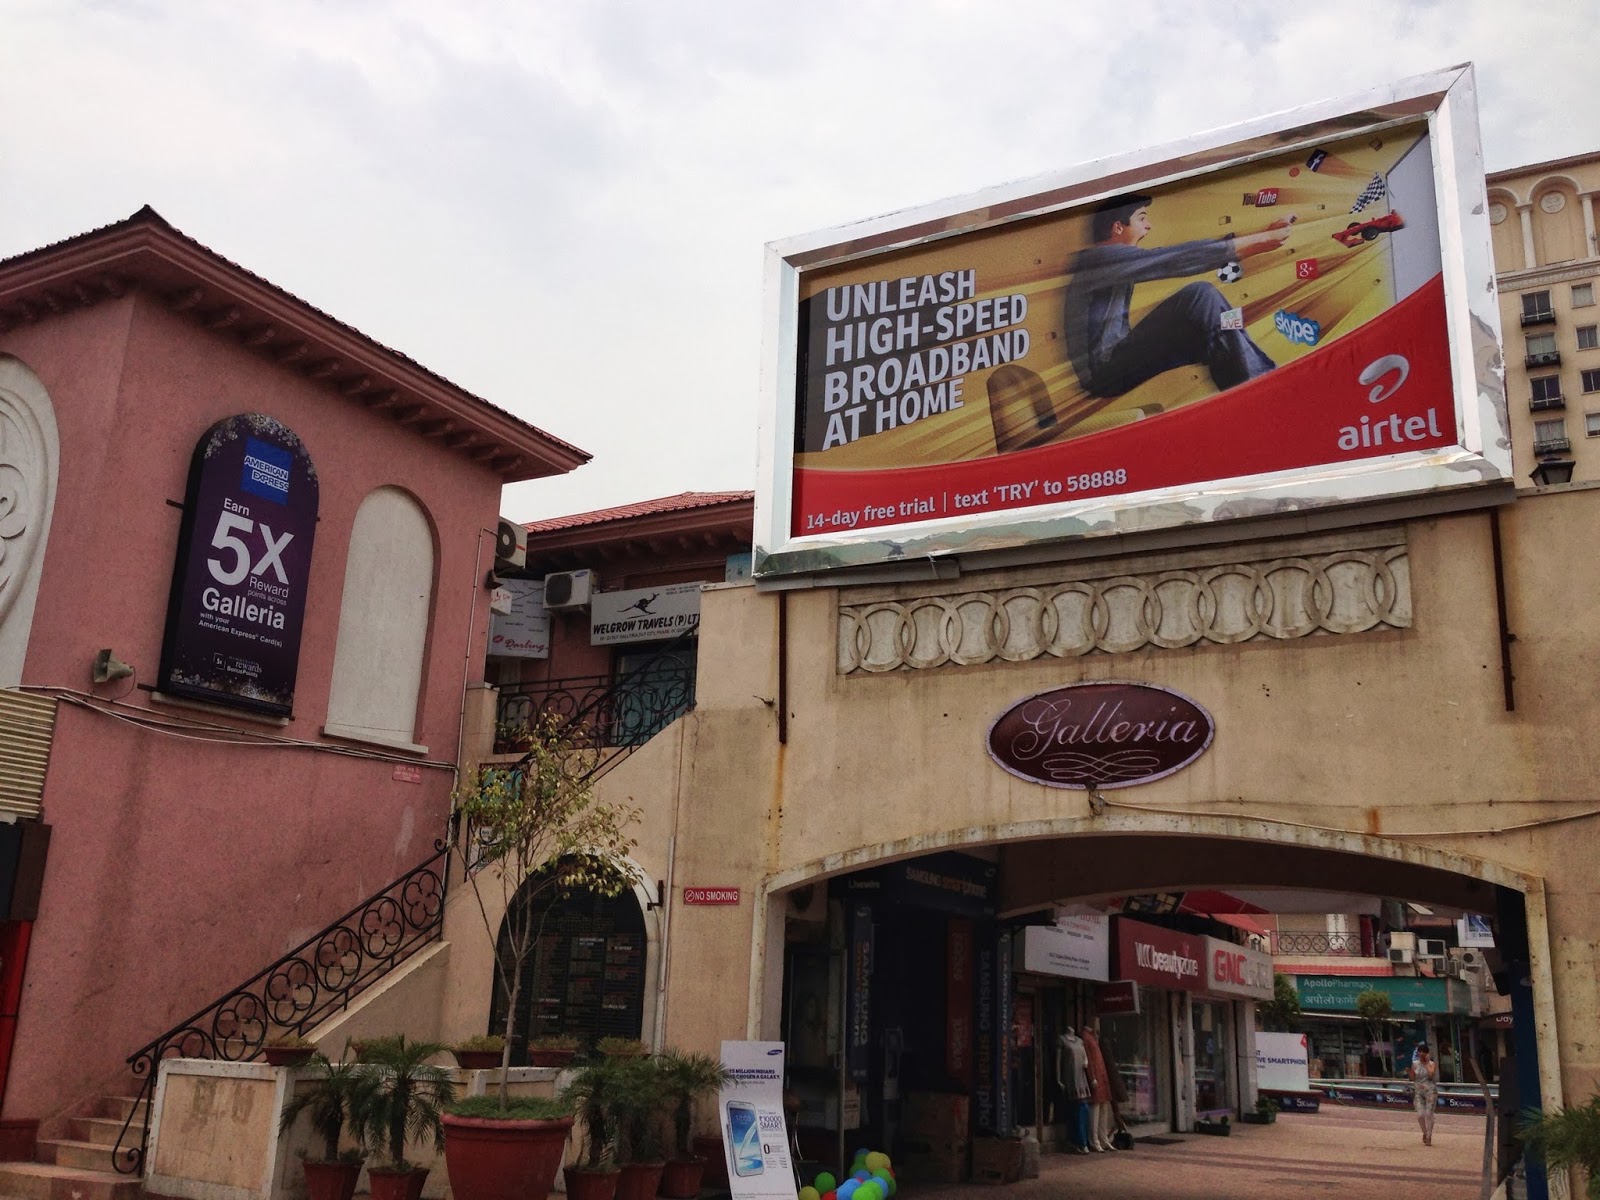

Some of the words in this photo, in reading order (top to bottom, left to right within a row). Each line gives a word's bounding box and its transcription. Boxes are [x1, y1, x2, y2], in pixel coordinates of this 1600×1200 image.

[826, 268, 976, 322] UNLEASH
[825, 293, 1028, 366] HIGH-SPEED
[1221, 319, 1242, 329] LIVE
[1275, 313, 1315, 342] skype
[824, 328, 1030, 413] BROADBAND
[821, 405, 867, 451] AT
[875, 377, 965, 434] HOME
[1337, 407, 1443, 451] airtel
[244, 455, 289, 481] AMERICAN
[251, 469, 290, 493] EXPRESS
[223, 497, 250, 516] Earn
[806, 507, 860, 530] 14-day
[863, 503, 896, 522] free
[899, 496, 936, 517] trial
[954, 489, 989, 509] text
[1043, 479, 1063, 496] to
[1067, 468, 1127, 492] 58888
[247, 589, 266, 600] points
[267, 594, 287, 606] across
[249, 576, 289, 598] Reward
[200, 612, 214, 620] with
[215, 615, 230, 625] your
[202, 587, 285, 630] Galleria
[198, 620, 229, 633] American
[260, 635, 283, 648] Card(s)
[593, 619, 637, 635] WELGROW
[638, 616, 674, 630] TRAVELS
[505, 640, 545, 653] Darling
[1011, 699, 1199, 761] Galleria
[694, 891, 705, 901] NO
[706, 891, 738, 901] SMOKING
[1213, 950, 1248, 985] GNC
